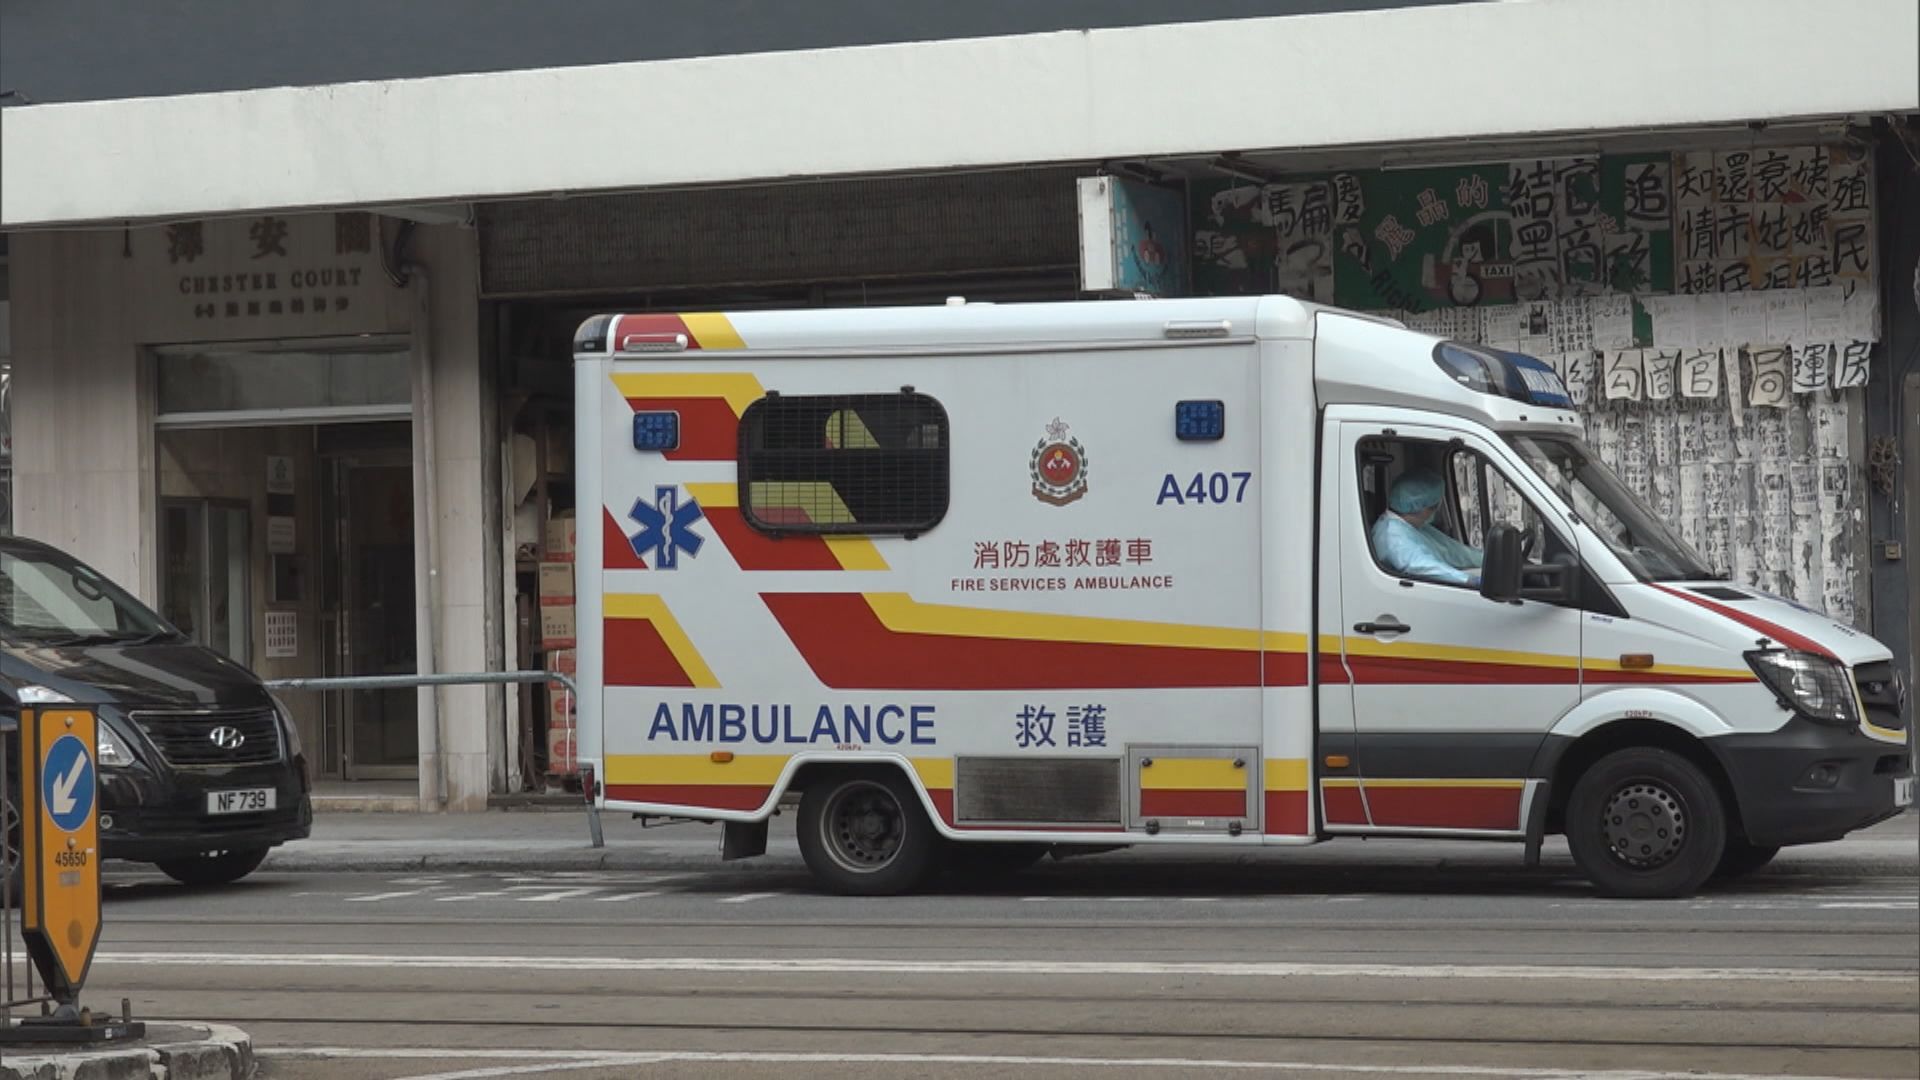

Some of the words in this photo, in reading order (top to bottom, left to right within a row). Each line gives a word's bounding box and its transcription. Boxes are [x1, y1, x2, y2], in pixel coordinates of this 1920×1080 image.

[179, 273, 278, 294] CHESTER
[290, 267, 362, 287] COURT
[1156, 472, 1252, 505] A407
[973, 538, 1154, 569] 消防處救護車
[951, 578, 985, 592] FIRE
[989, 577, 1067, 591] SERVICES
[1074, 575, 1174, 590] AMBULANCE
[648, 702, 937, 746] AMBULANCE
[1016, 704, 1109, 749] 救護
[217, 793, 236, 811] NF
[239, 791, 266, 808] 739
[55, 852, 87, 868] 45650
